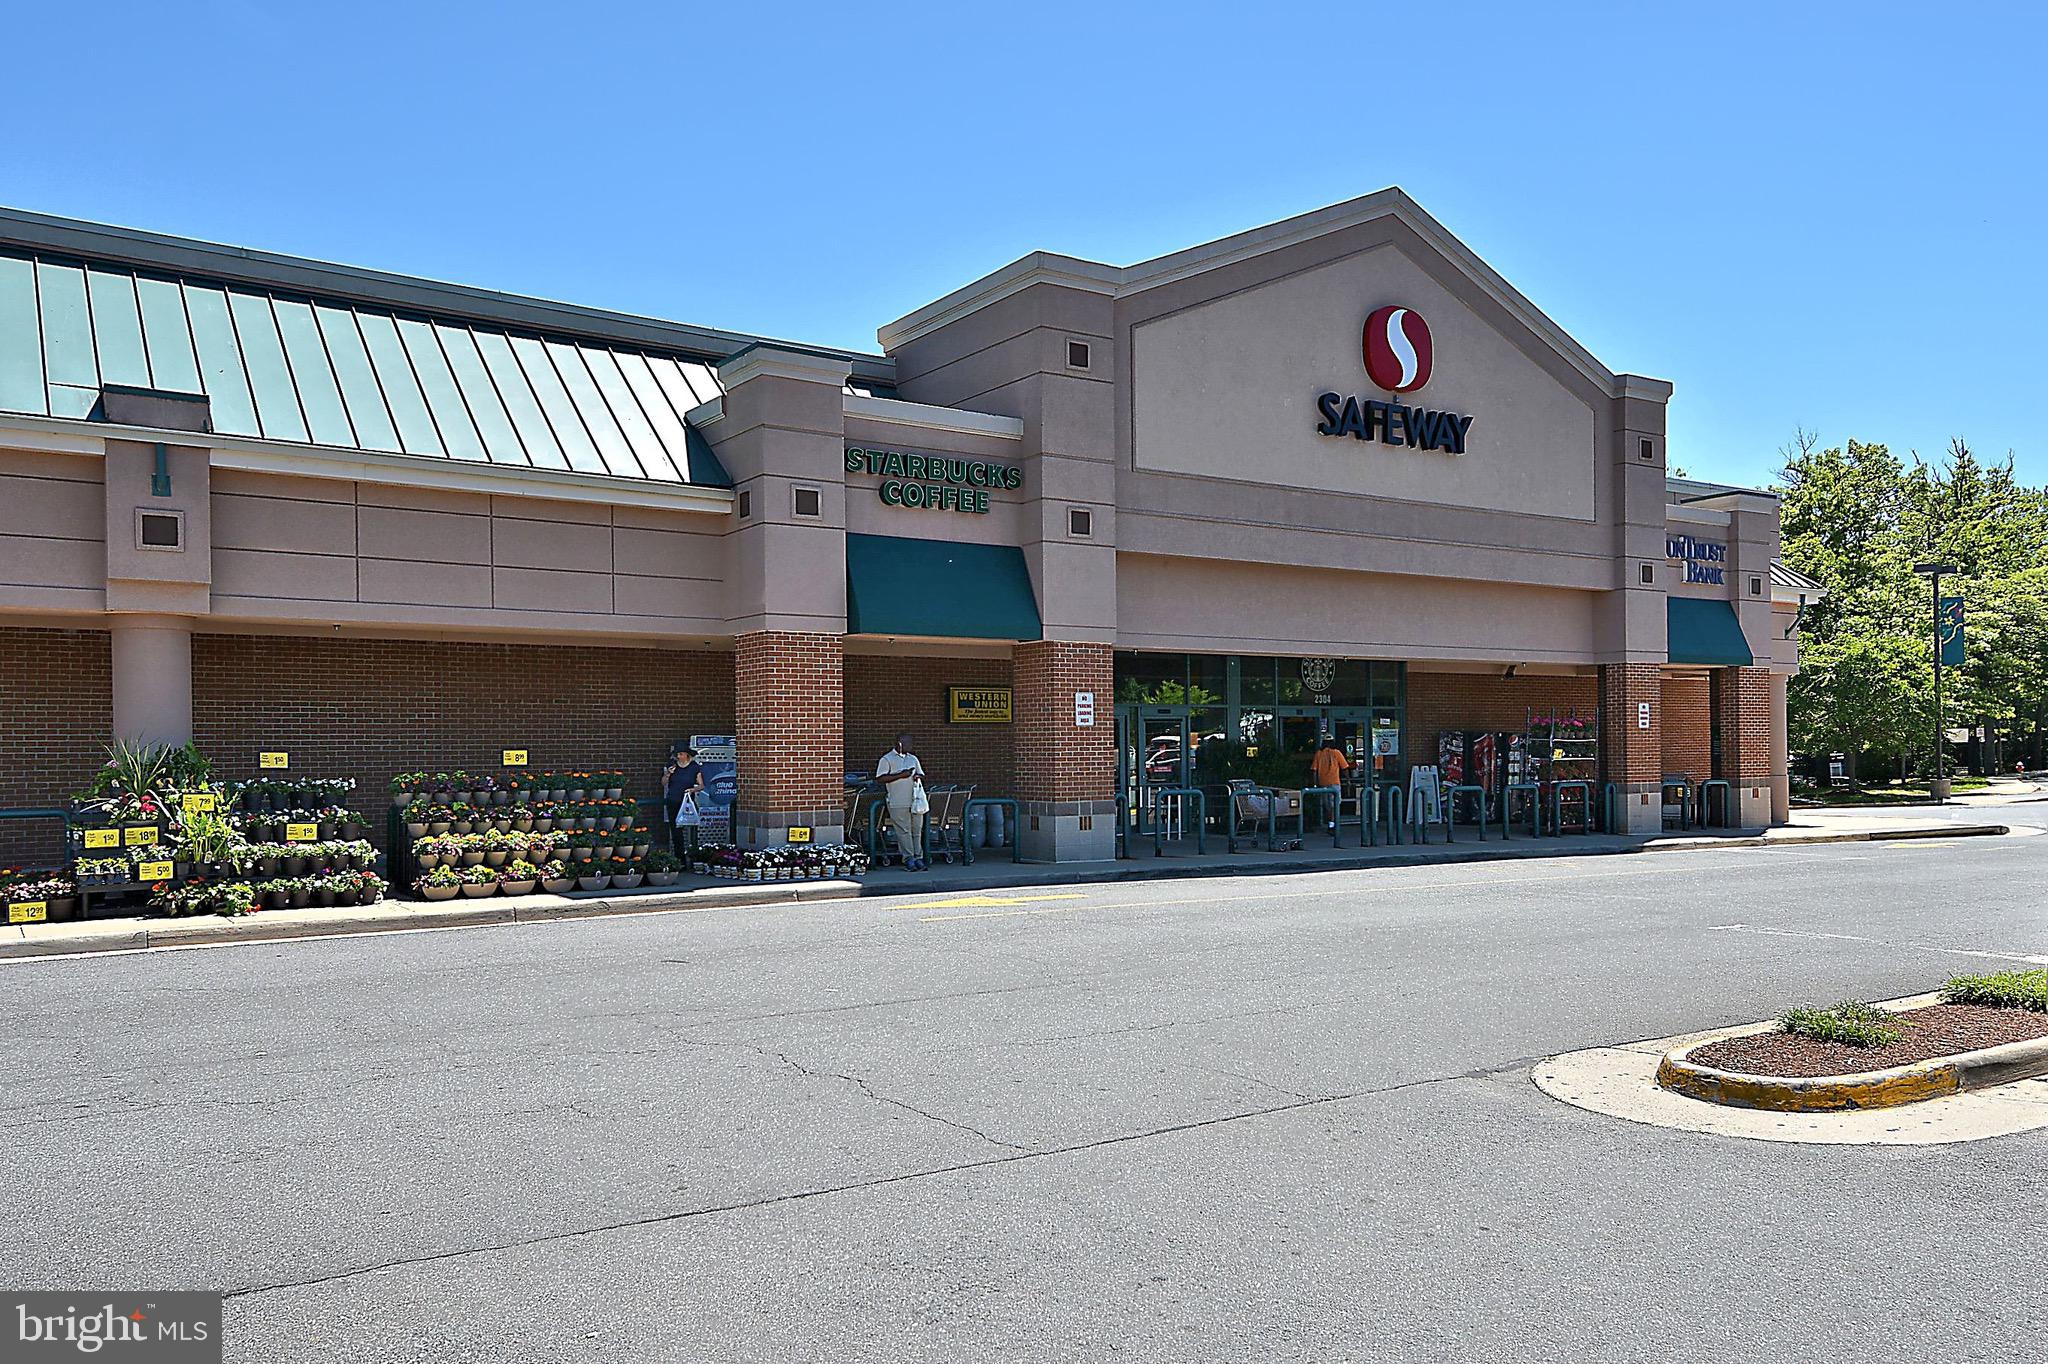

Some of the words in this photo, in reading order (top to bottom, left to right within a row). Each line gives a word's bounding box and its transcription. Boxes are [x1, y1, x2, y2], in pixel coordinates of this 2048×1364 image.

[1316, 391, 1474, 455] SAFEWAY
[845, 447, 1022, 490] STARBUCKS
[879, 479, 990, 514] COFFEE
[1681, 560, 1725, 585] BANK
[1306, 677, 1330, 689] COFFEE
[959, 692, 1007, 701] WESTERN
[974, 700, 1007, 709] UNION
[1314, 694, 1331, 704] 2304
